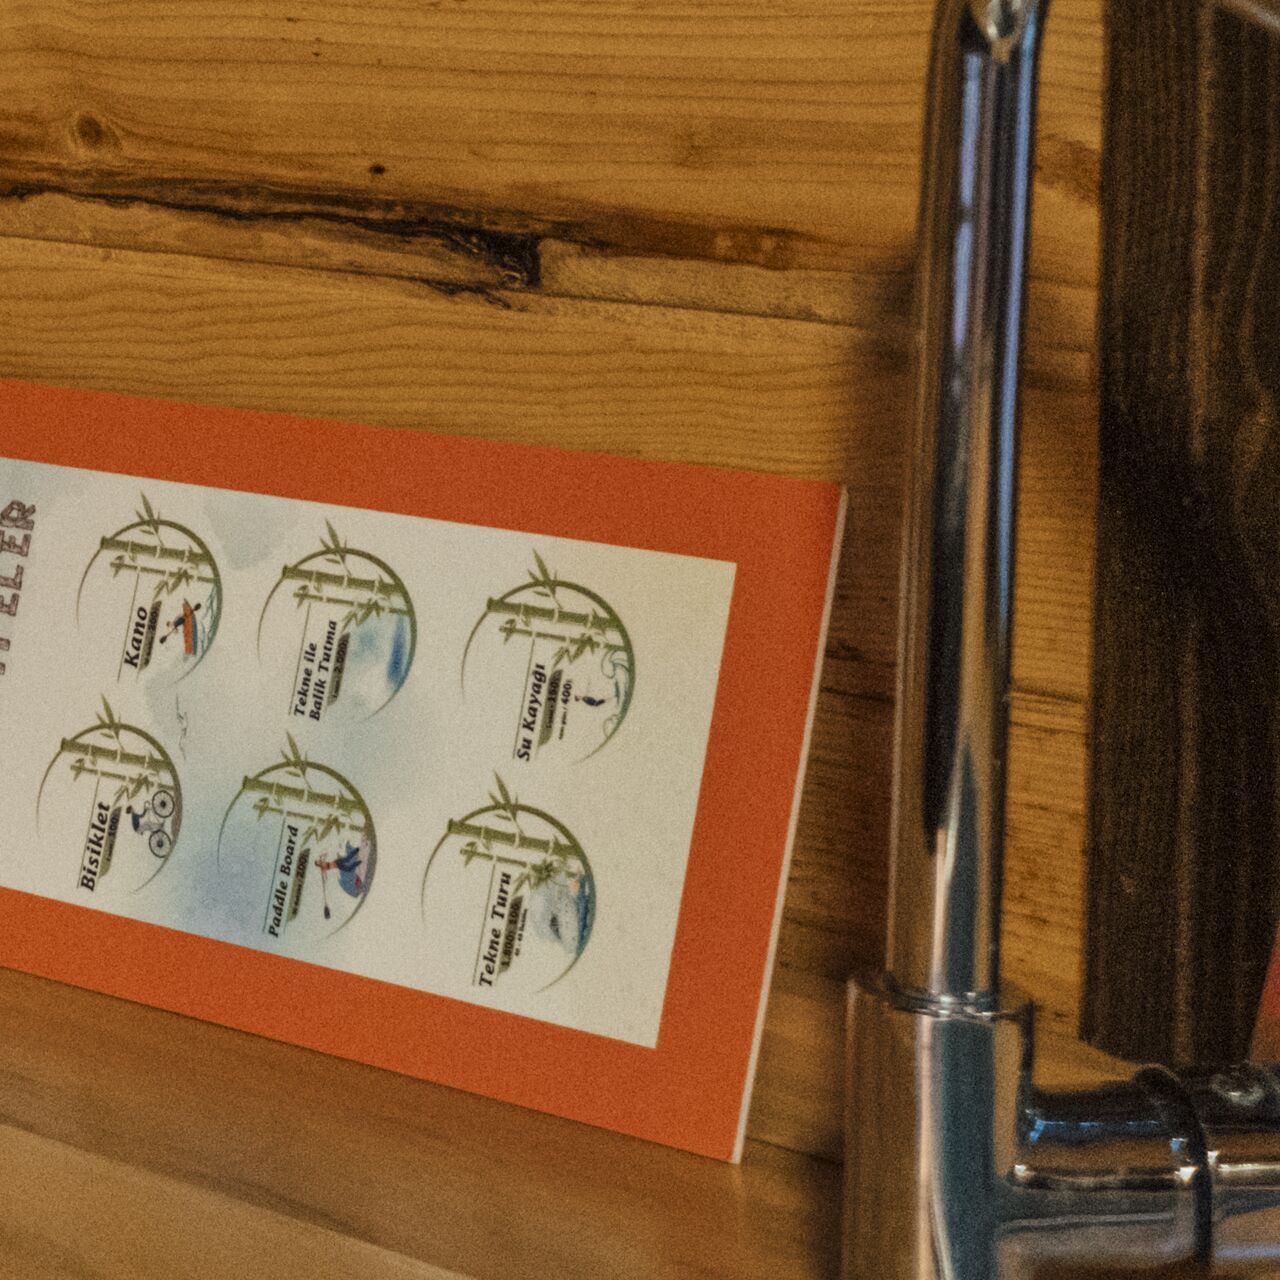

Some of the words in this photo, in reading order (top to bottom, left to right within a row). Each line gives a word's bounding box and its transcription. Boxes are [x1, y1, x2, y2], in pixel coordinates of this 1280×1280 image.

[124, 607, 152, 667] Kano
[318, 621, 336, 671] Tutma
[295, 669, 312, 715] Tekne
[305, 644, 316, 662] ile
[522, 664, 546, 731] Kayağı
[518, 738, 532, 760] Su
[81, 803, 114, 890] Bisiklet
[269, 882, 287, 937] Paddle
[280, 825, 298, 876] Board
[480, 929, 500, 985] Tekne
[492, 873, 510, 918] Turu
